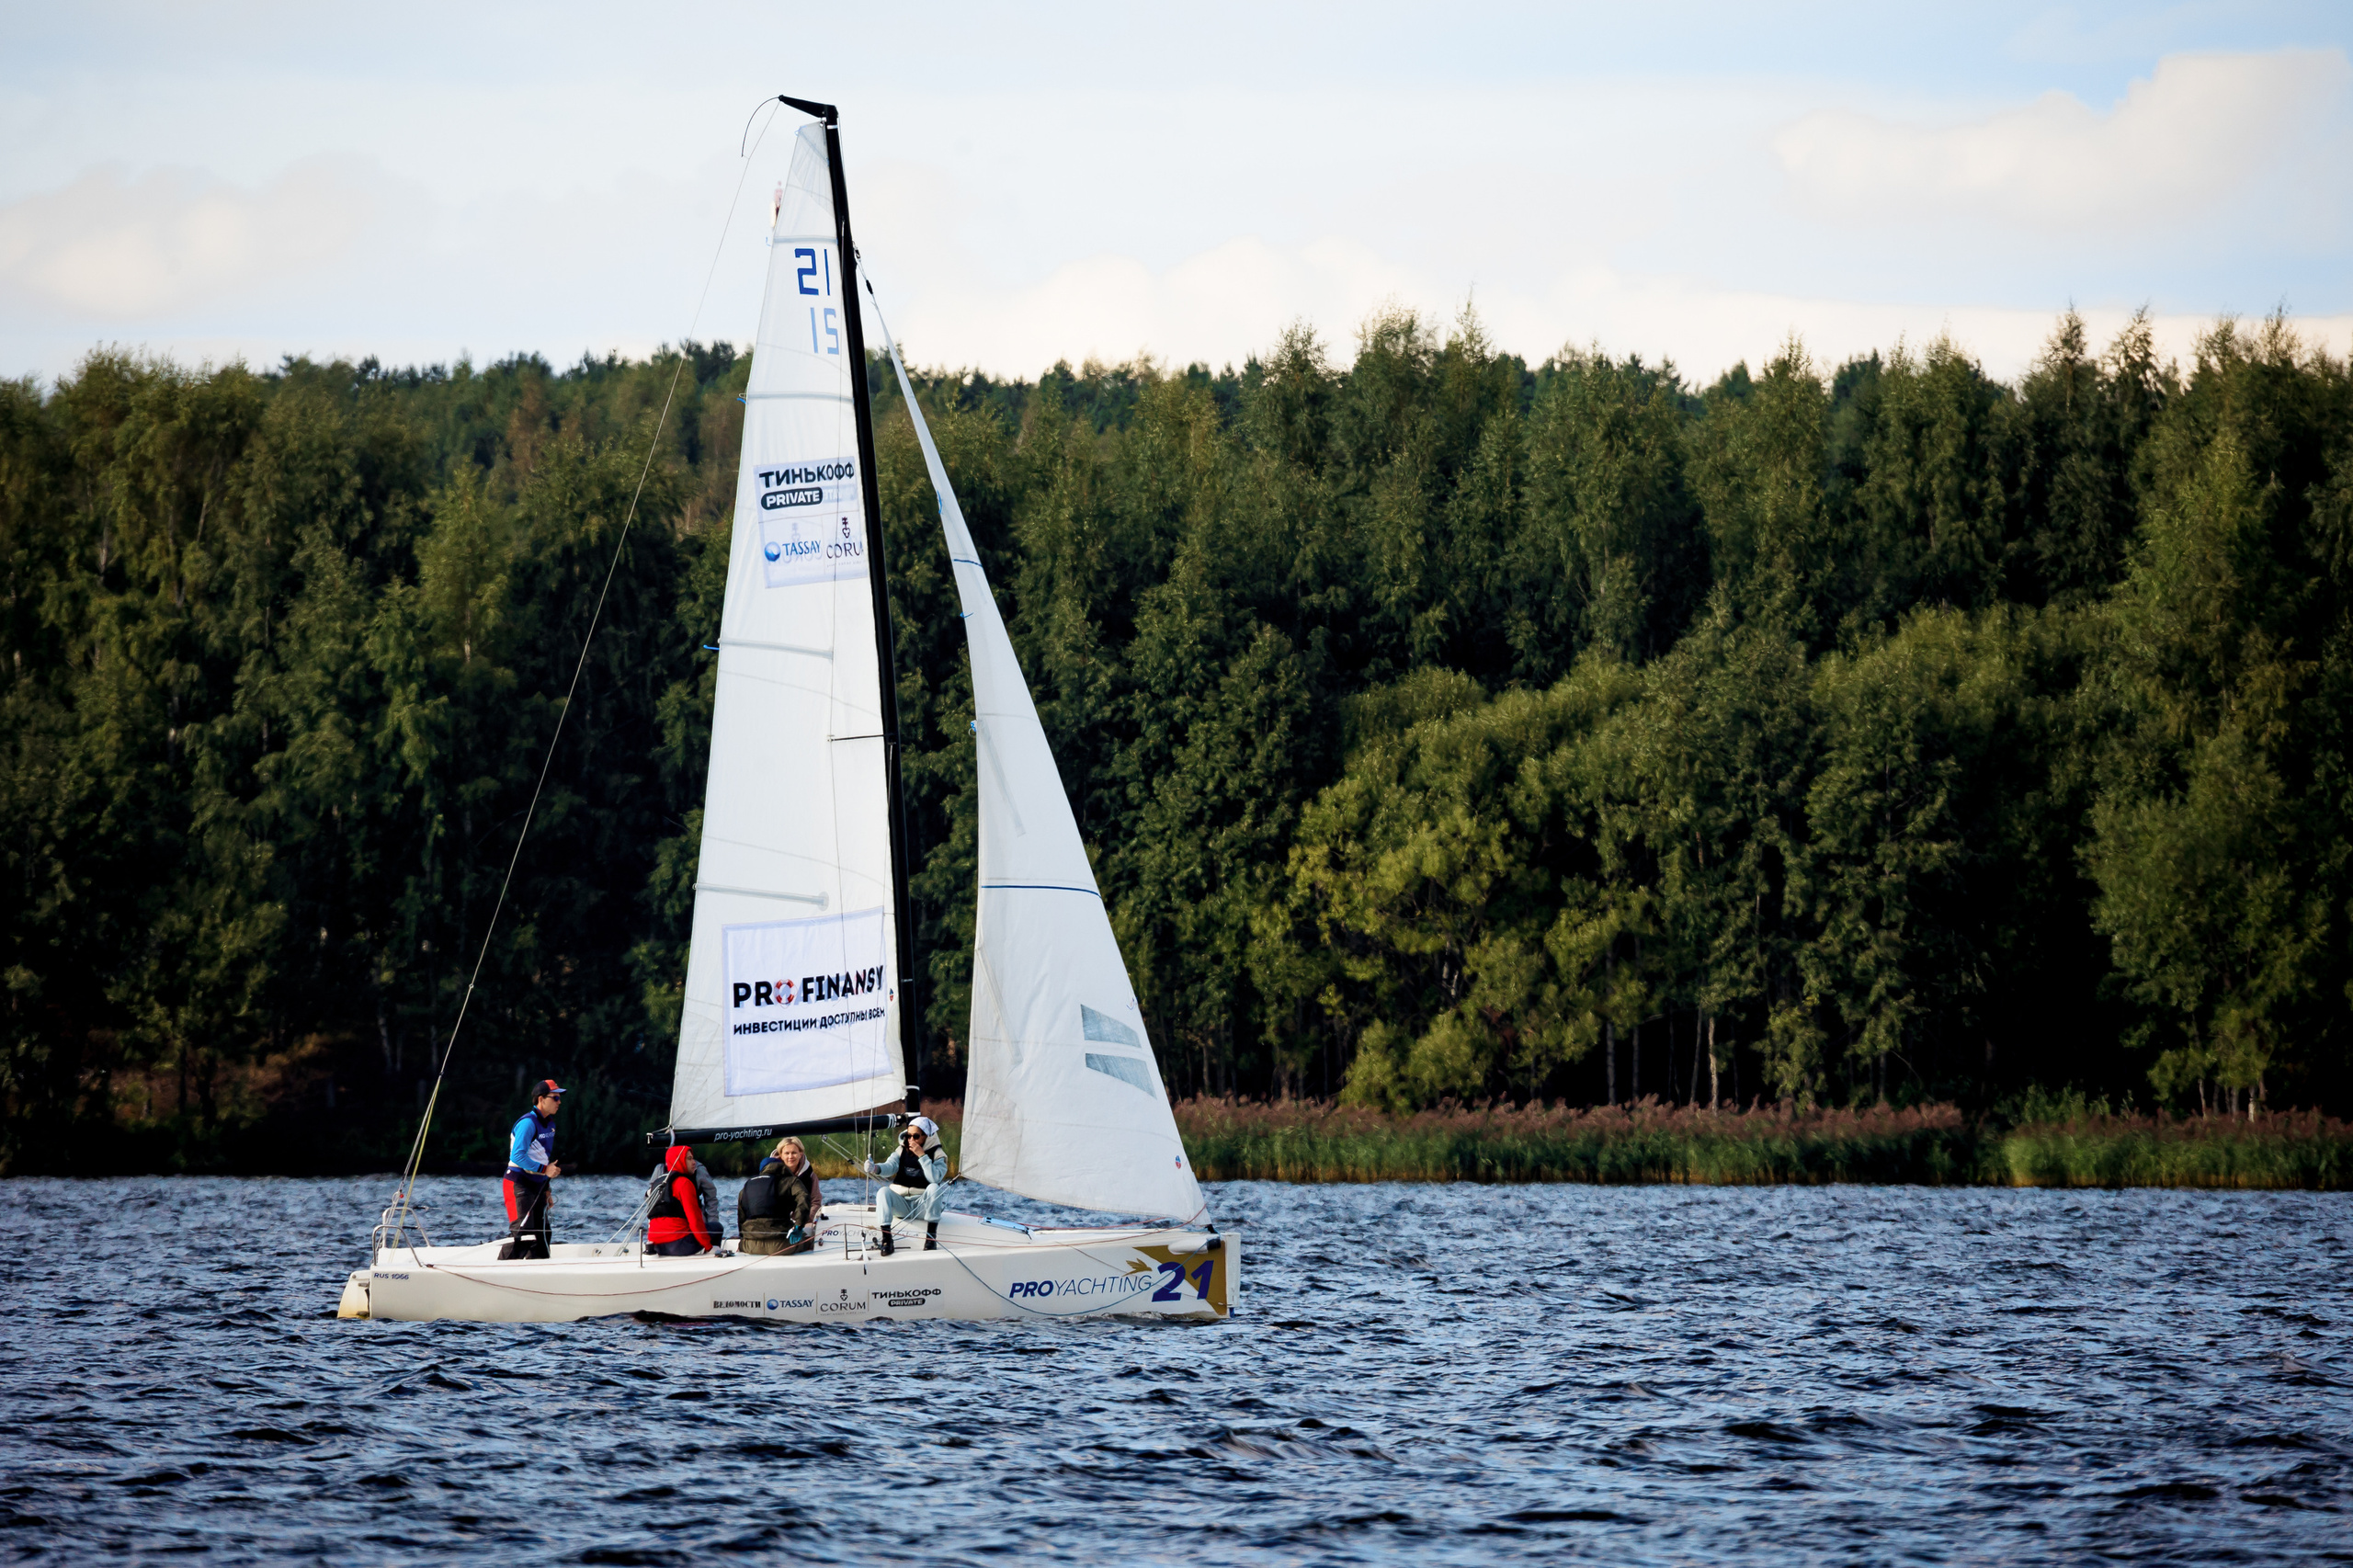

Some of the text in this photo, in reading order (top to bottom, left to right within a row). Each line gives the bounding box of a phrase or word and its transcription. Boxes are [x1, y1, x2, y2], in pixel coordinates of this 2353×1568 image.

[794, 247, 830, 296] 21
[759, 461, 855, 488] ТИНЬКОФФ
[766, 490, 820, 507] PRIVATE
[782, 540, 822, 556] TASSAY
[733, 1006, 885, 1036] ИНВЕСТИЦИИ ДОСТУПНЫ ВСЕМ
[1009, 1260, 1214, 1302] PROYACHTING 21
[871, 1288, 942, 1300] ТИНЬКОФФ
[713, 1300, 761, 1309] ВЕДОМОСТИ
[779, 1299, 814, 1308] TASSAY
[820, 1301, 866, 1312] CORUM
[890, 1298, 924, 1307] PRIVATE
